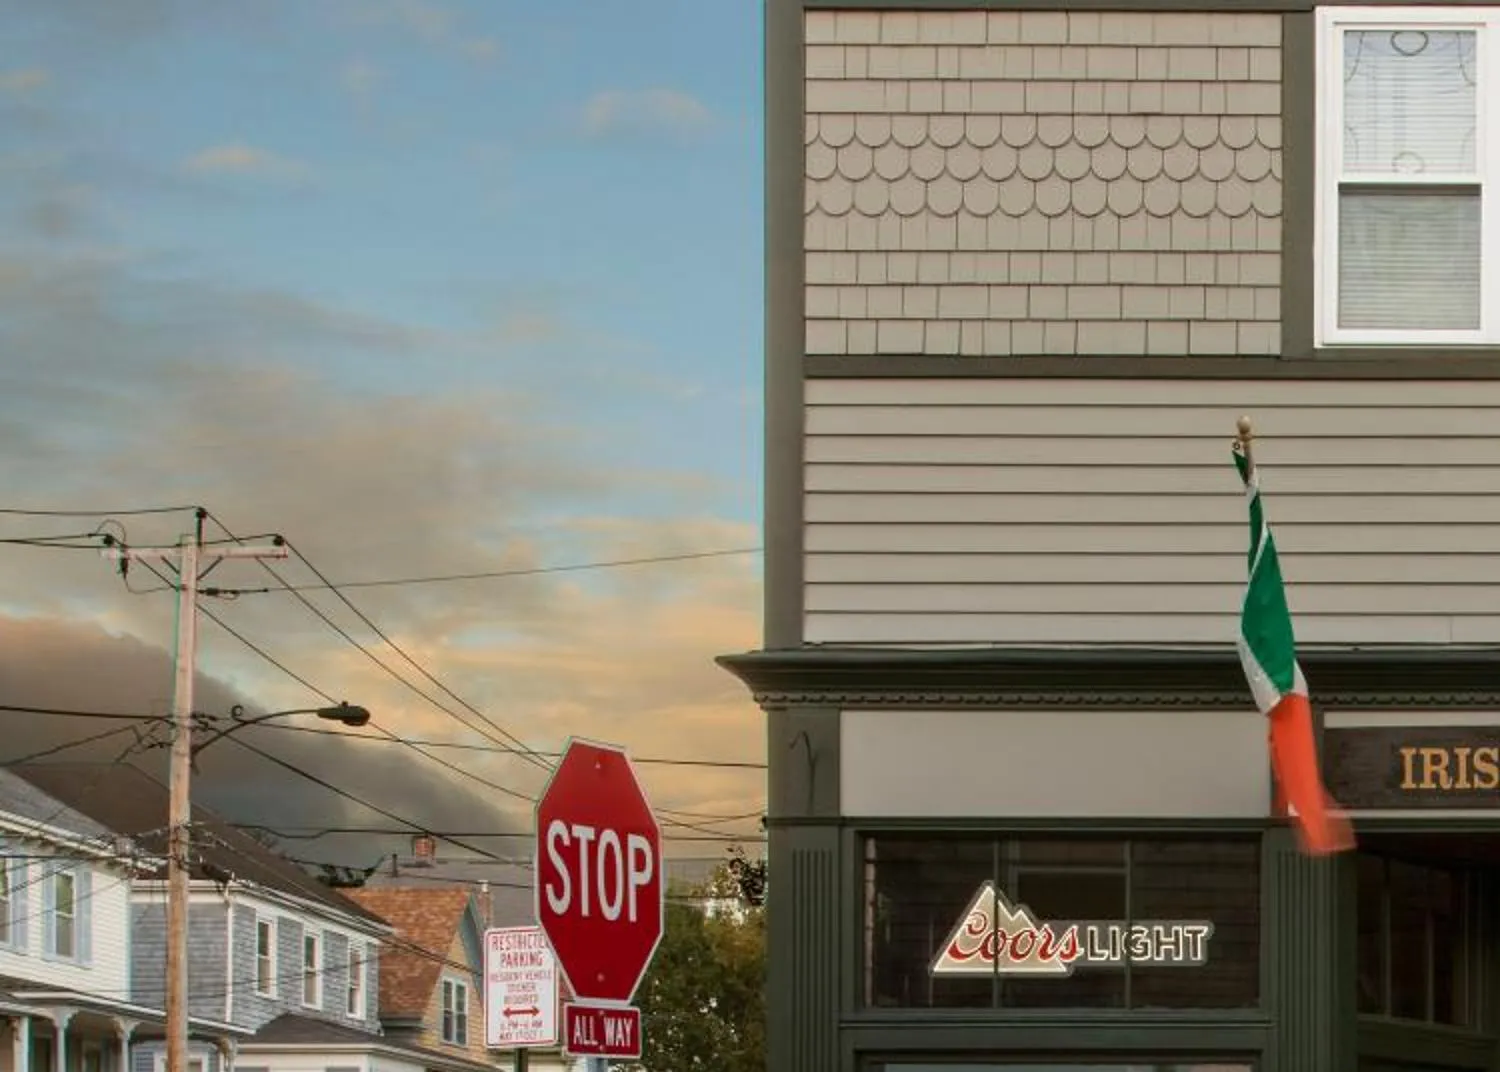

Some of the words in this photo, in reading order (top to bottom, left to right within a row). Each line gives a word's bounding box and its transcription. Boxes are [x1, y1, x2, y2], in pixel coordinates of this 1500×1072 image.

[545, 819, 653, 922] STOP
[947, 911, 1083, 963] Coors
[1087, 925, 1209, 962] LIGHT
[500, 951, 544, 968] PARKING
[573, 1015, 599, 1045] ALL
[604, 1017, 633, 1048] WAY
